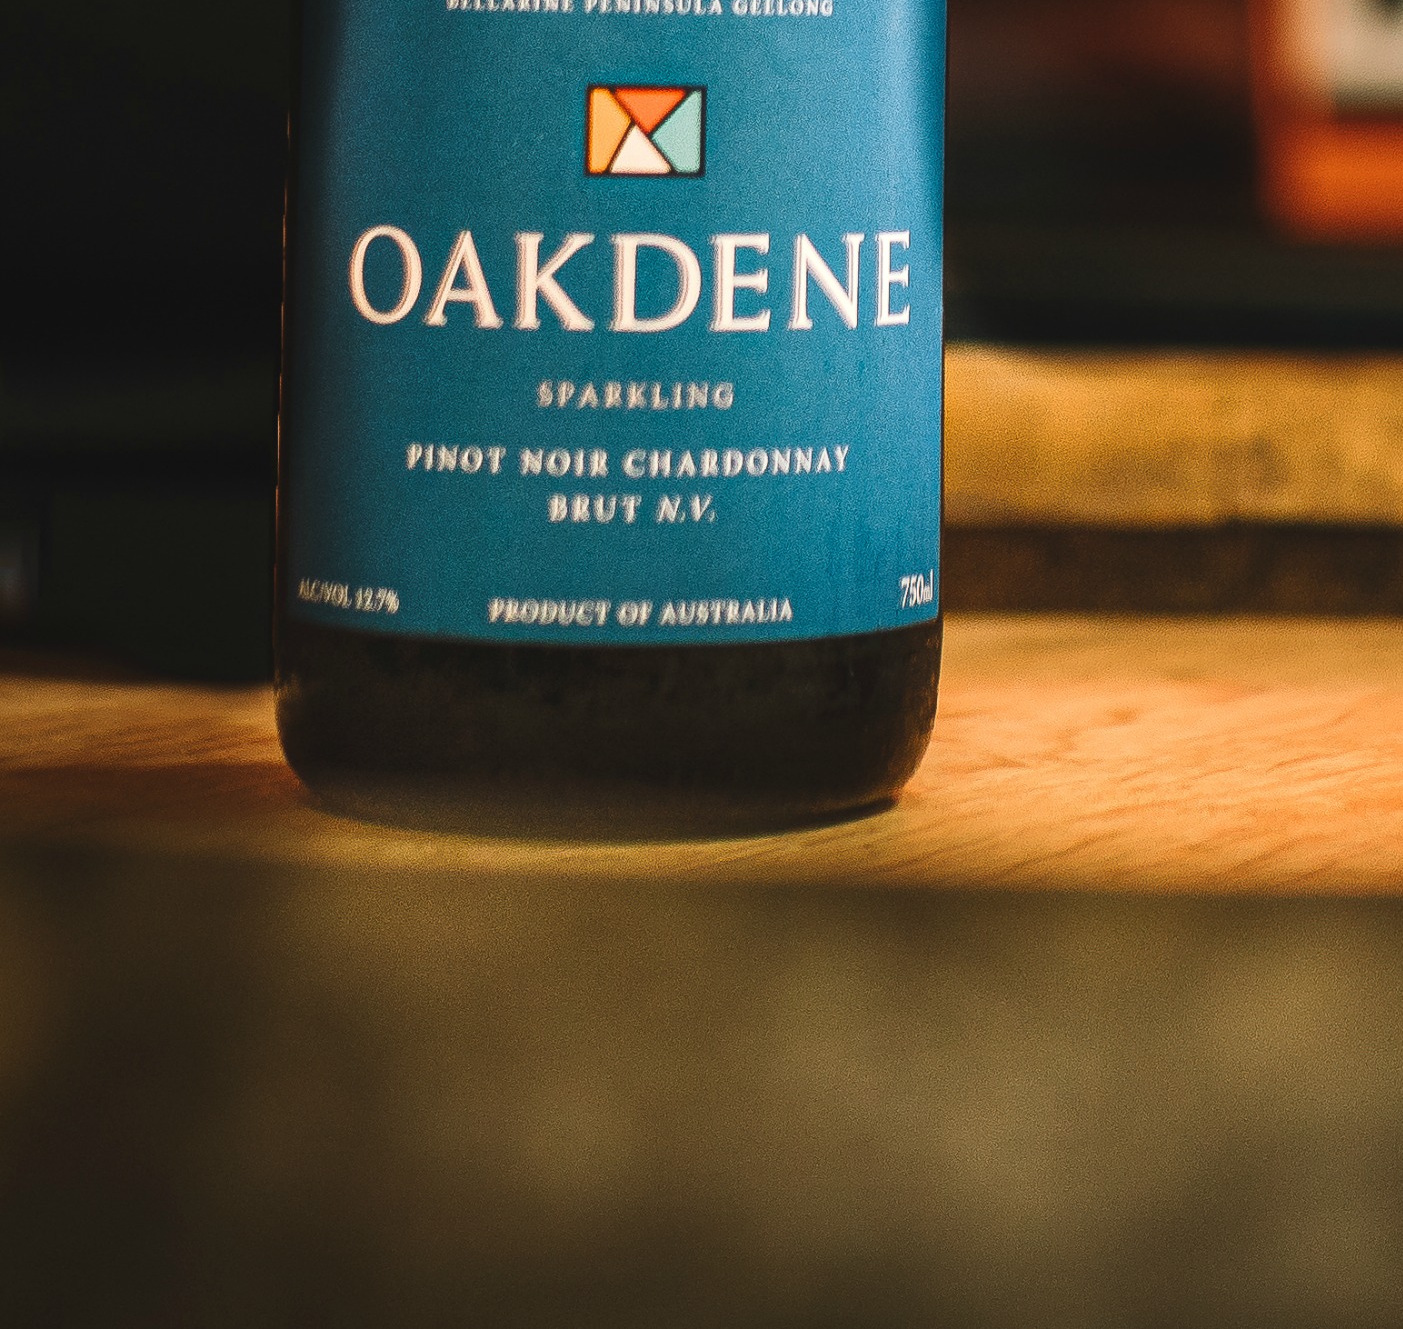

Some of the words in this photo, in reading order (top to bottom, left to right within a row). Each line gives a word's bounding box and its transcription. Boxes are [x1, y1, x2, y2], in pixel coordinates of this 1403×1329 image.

[348, 225, 911, 333] OAKDENE
[536, 380, 735, 410] SPARKLING
[405, 442, 507, 475] PINOT
[519, 448, 609, 477] NOIR
[622, 445, 850, 478] CHARDONNAY
[547, 494, 643, 524] BRUT
[655, 494, 717, 524] N.V.
[899, 568, 935, 610] 750ml
[487, 598, 611, 626] PRODUCT
[616, 600, 654, 627] OF
[659, 598, 794, 626] AUSTRALIA
